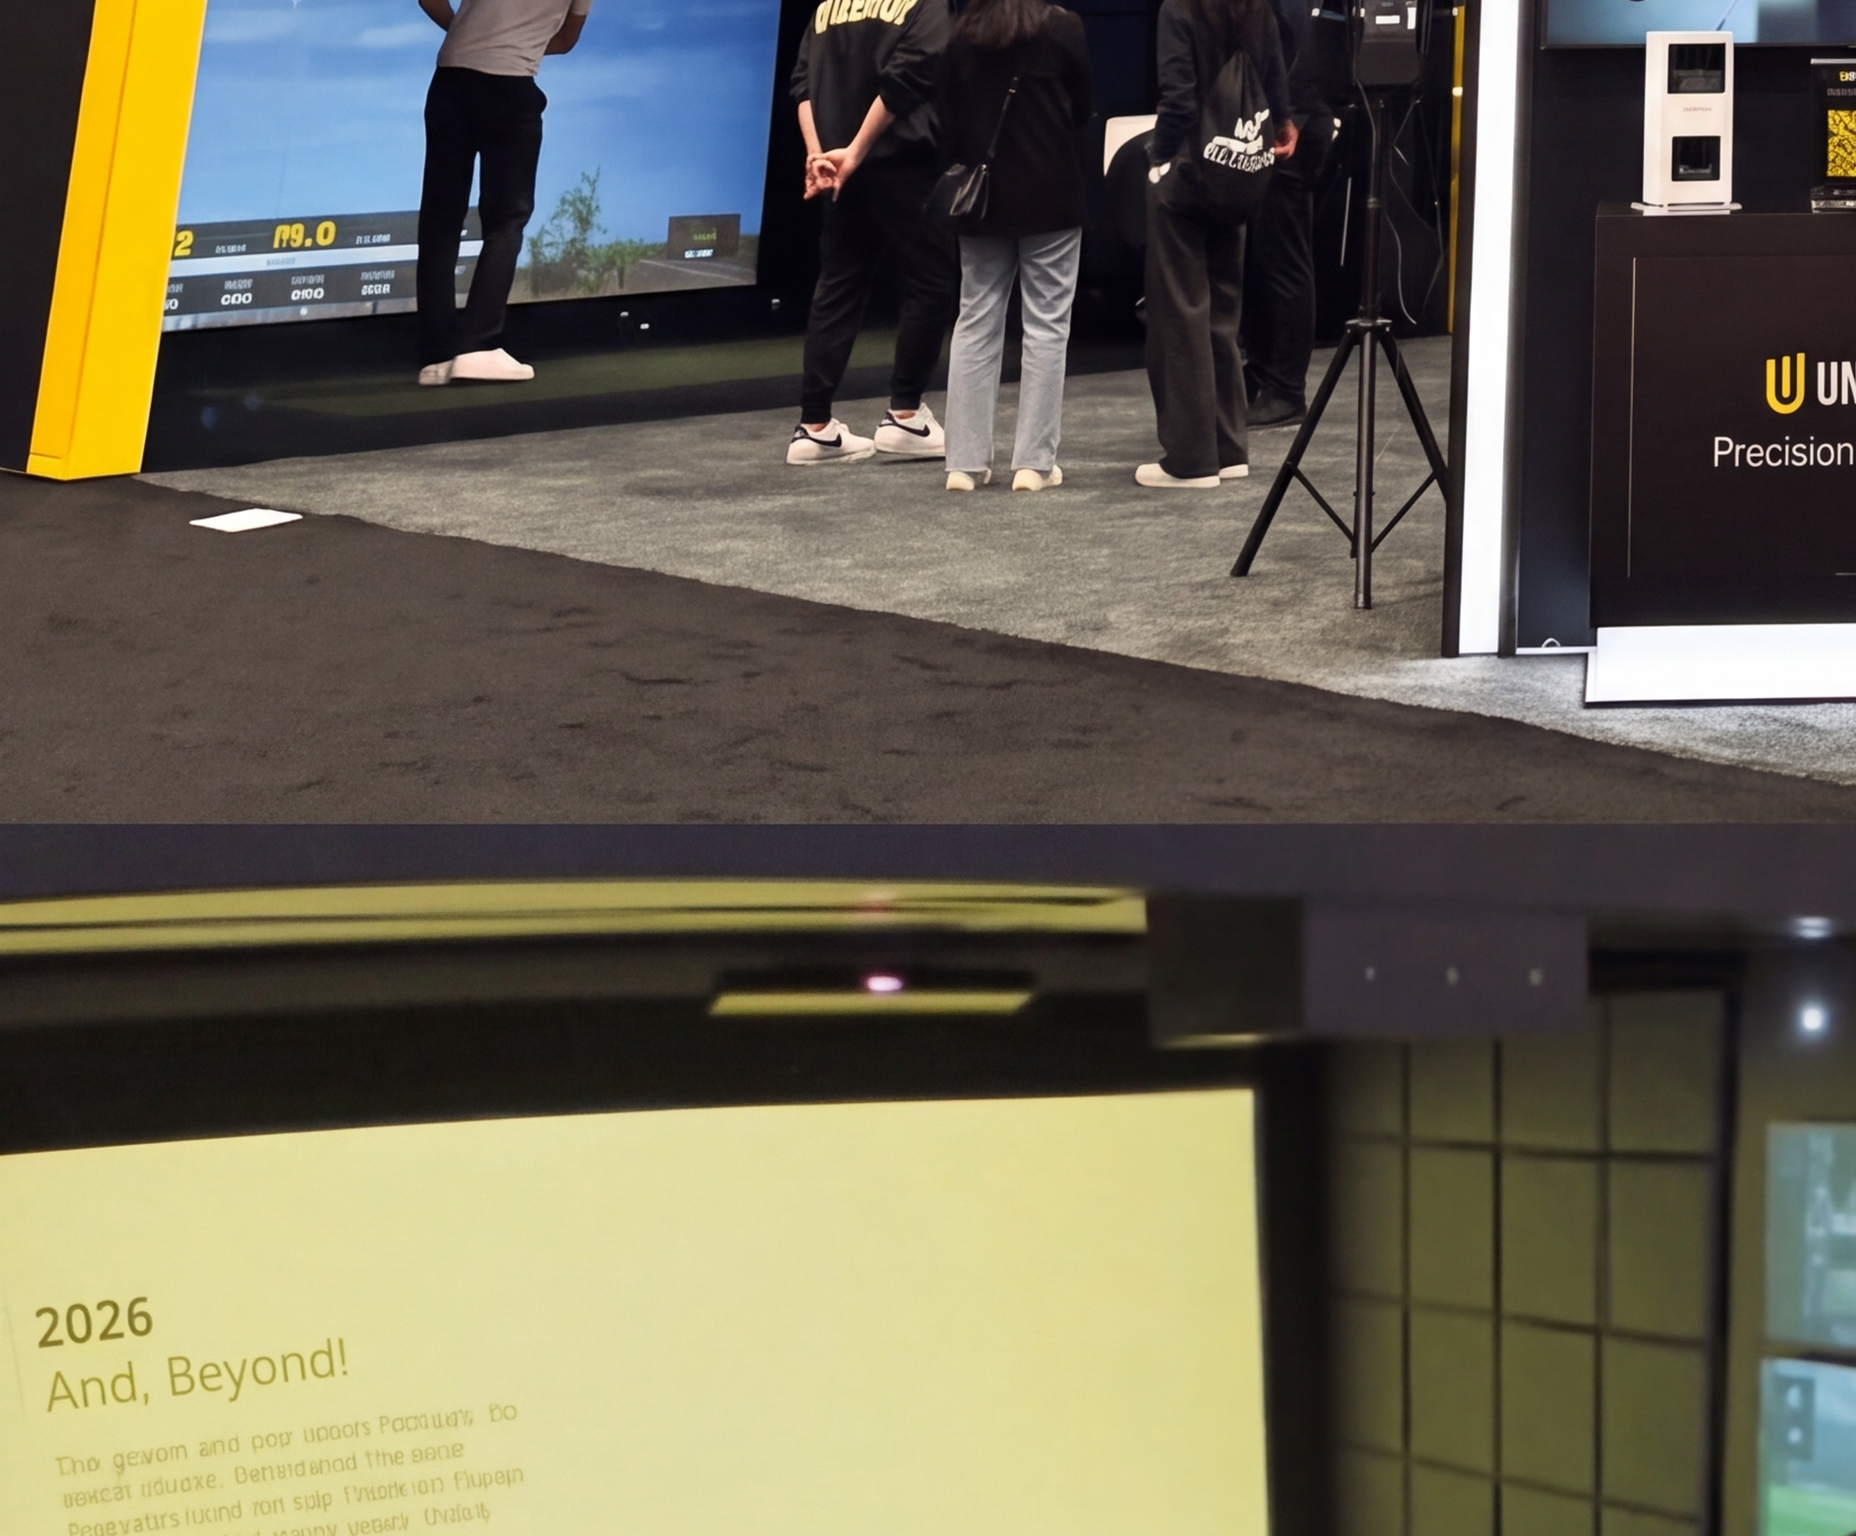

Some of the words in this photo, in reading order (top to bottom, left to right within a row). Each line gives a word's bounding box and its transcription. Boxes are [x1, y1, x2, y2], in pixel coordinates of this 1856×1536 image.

[1713, 435, 1854, 468] Precision
[35, 1296, 154, 1348] 2026
[46, 1361, 151, 1412] And,
[167, 1337, 349, 1402] Beyond!
